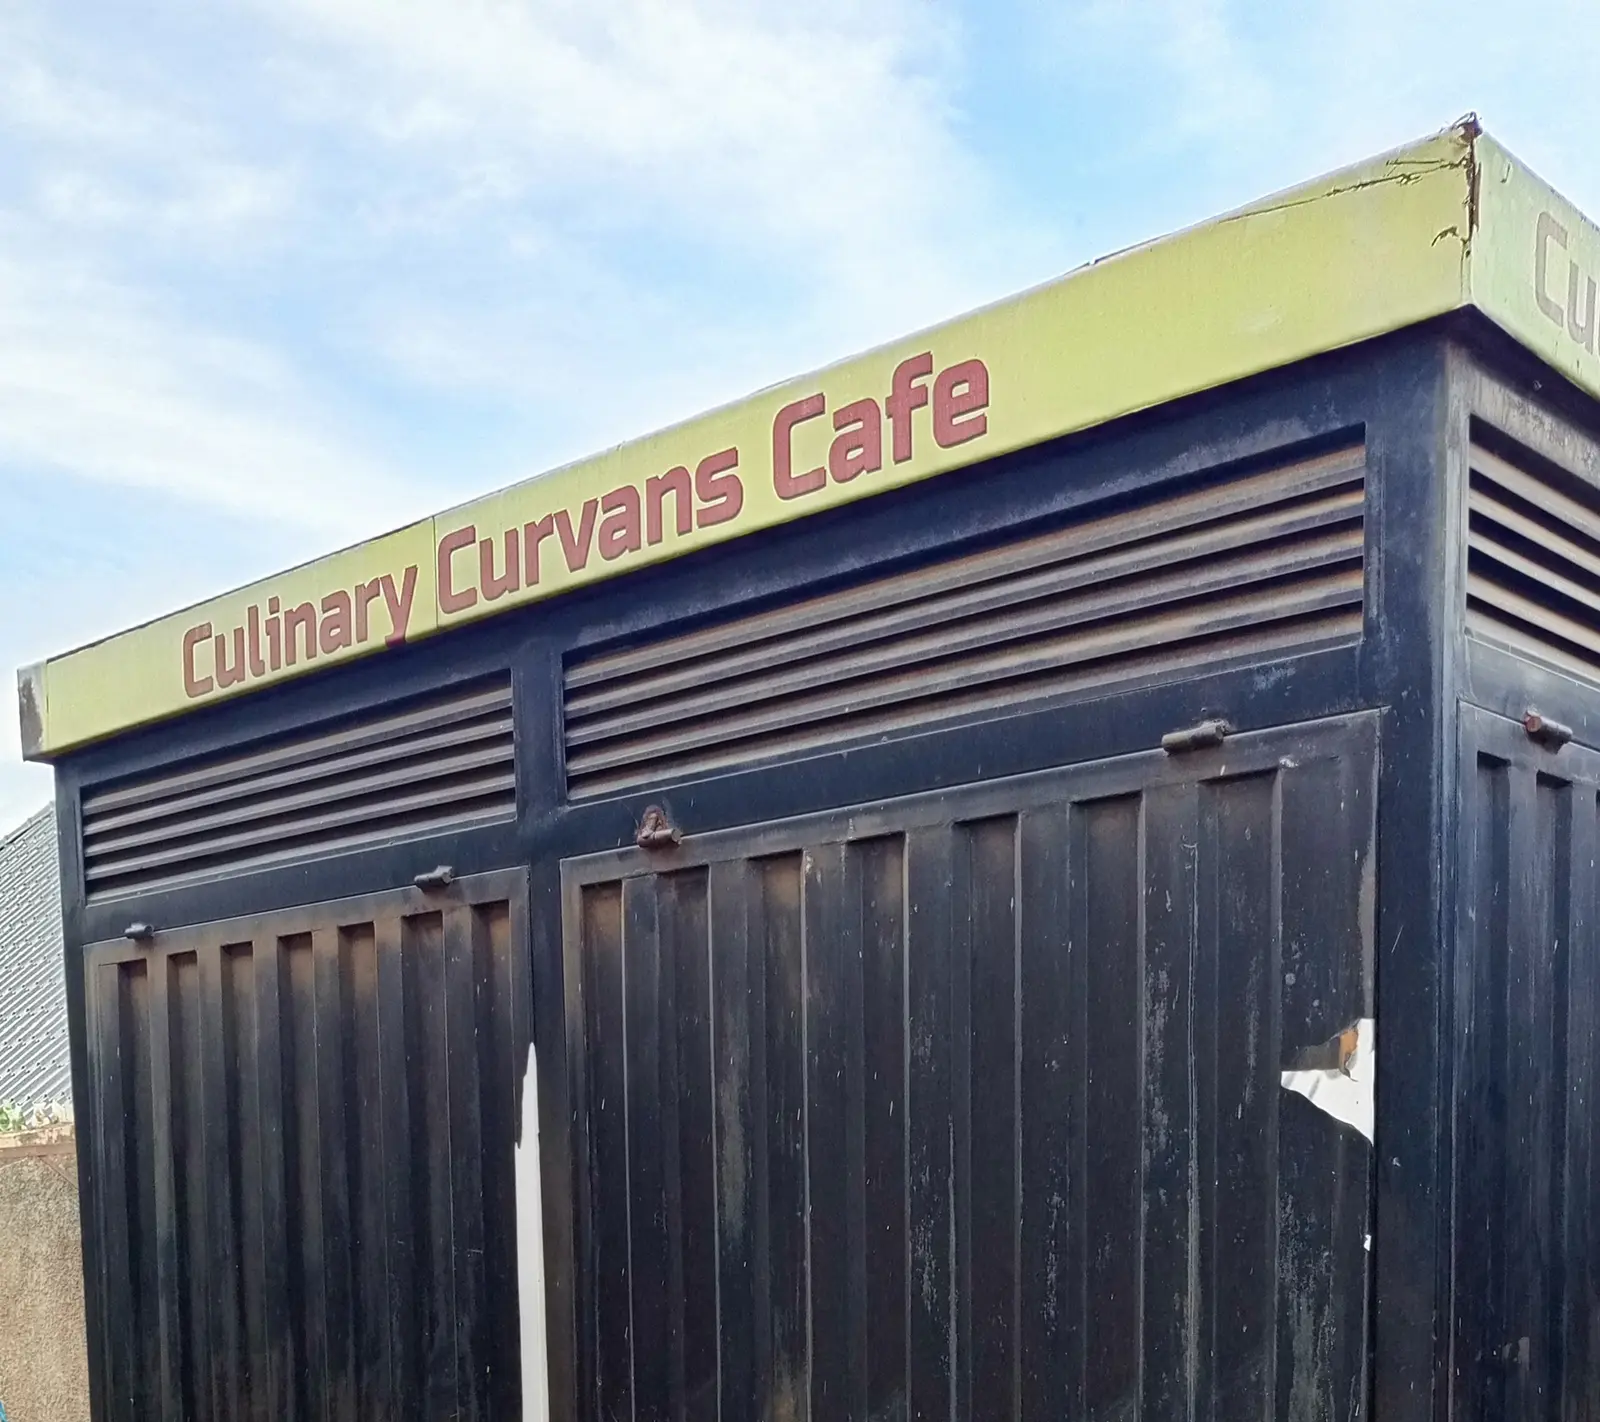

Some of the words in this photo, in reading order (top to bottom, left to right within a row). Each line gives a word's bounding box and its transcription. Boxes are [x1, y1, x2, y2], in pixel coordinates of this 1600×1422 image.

[1534, 211, 1600, 357] Cu
[182, 564, 419, 699] Culinary
[436, 446, 744, 615] Curvans
[771, 351, 990, 503] Cafe
